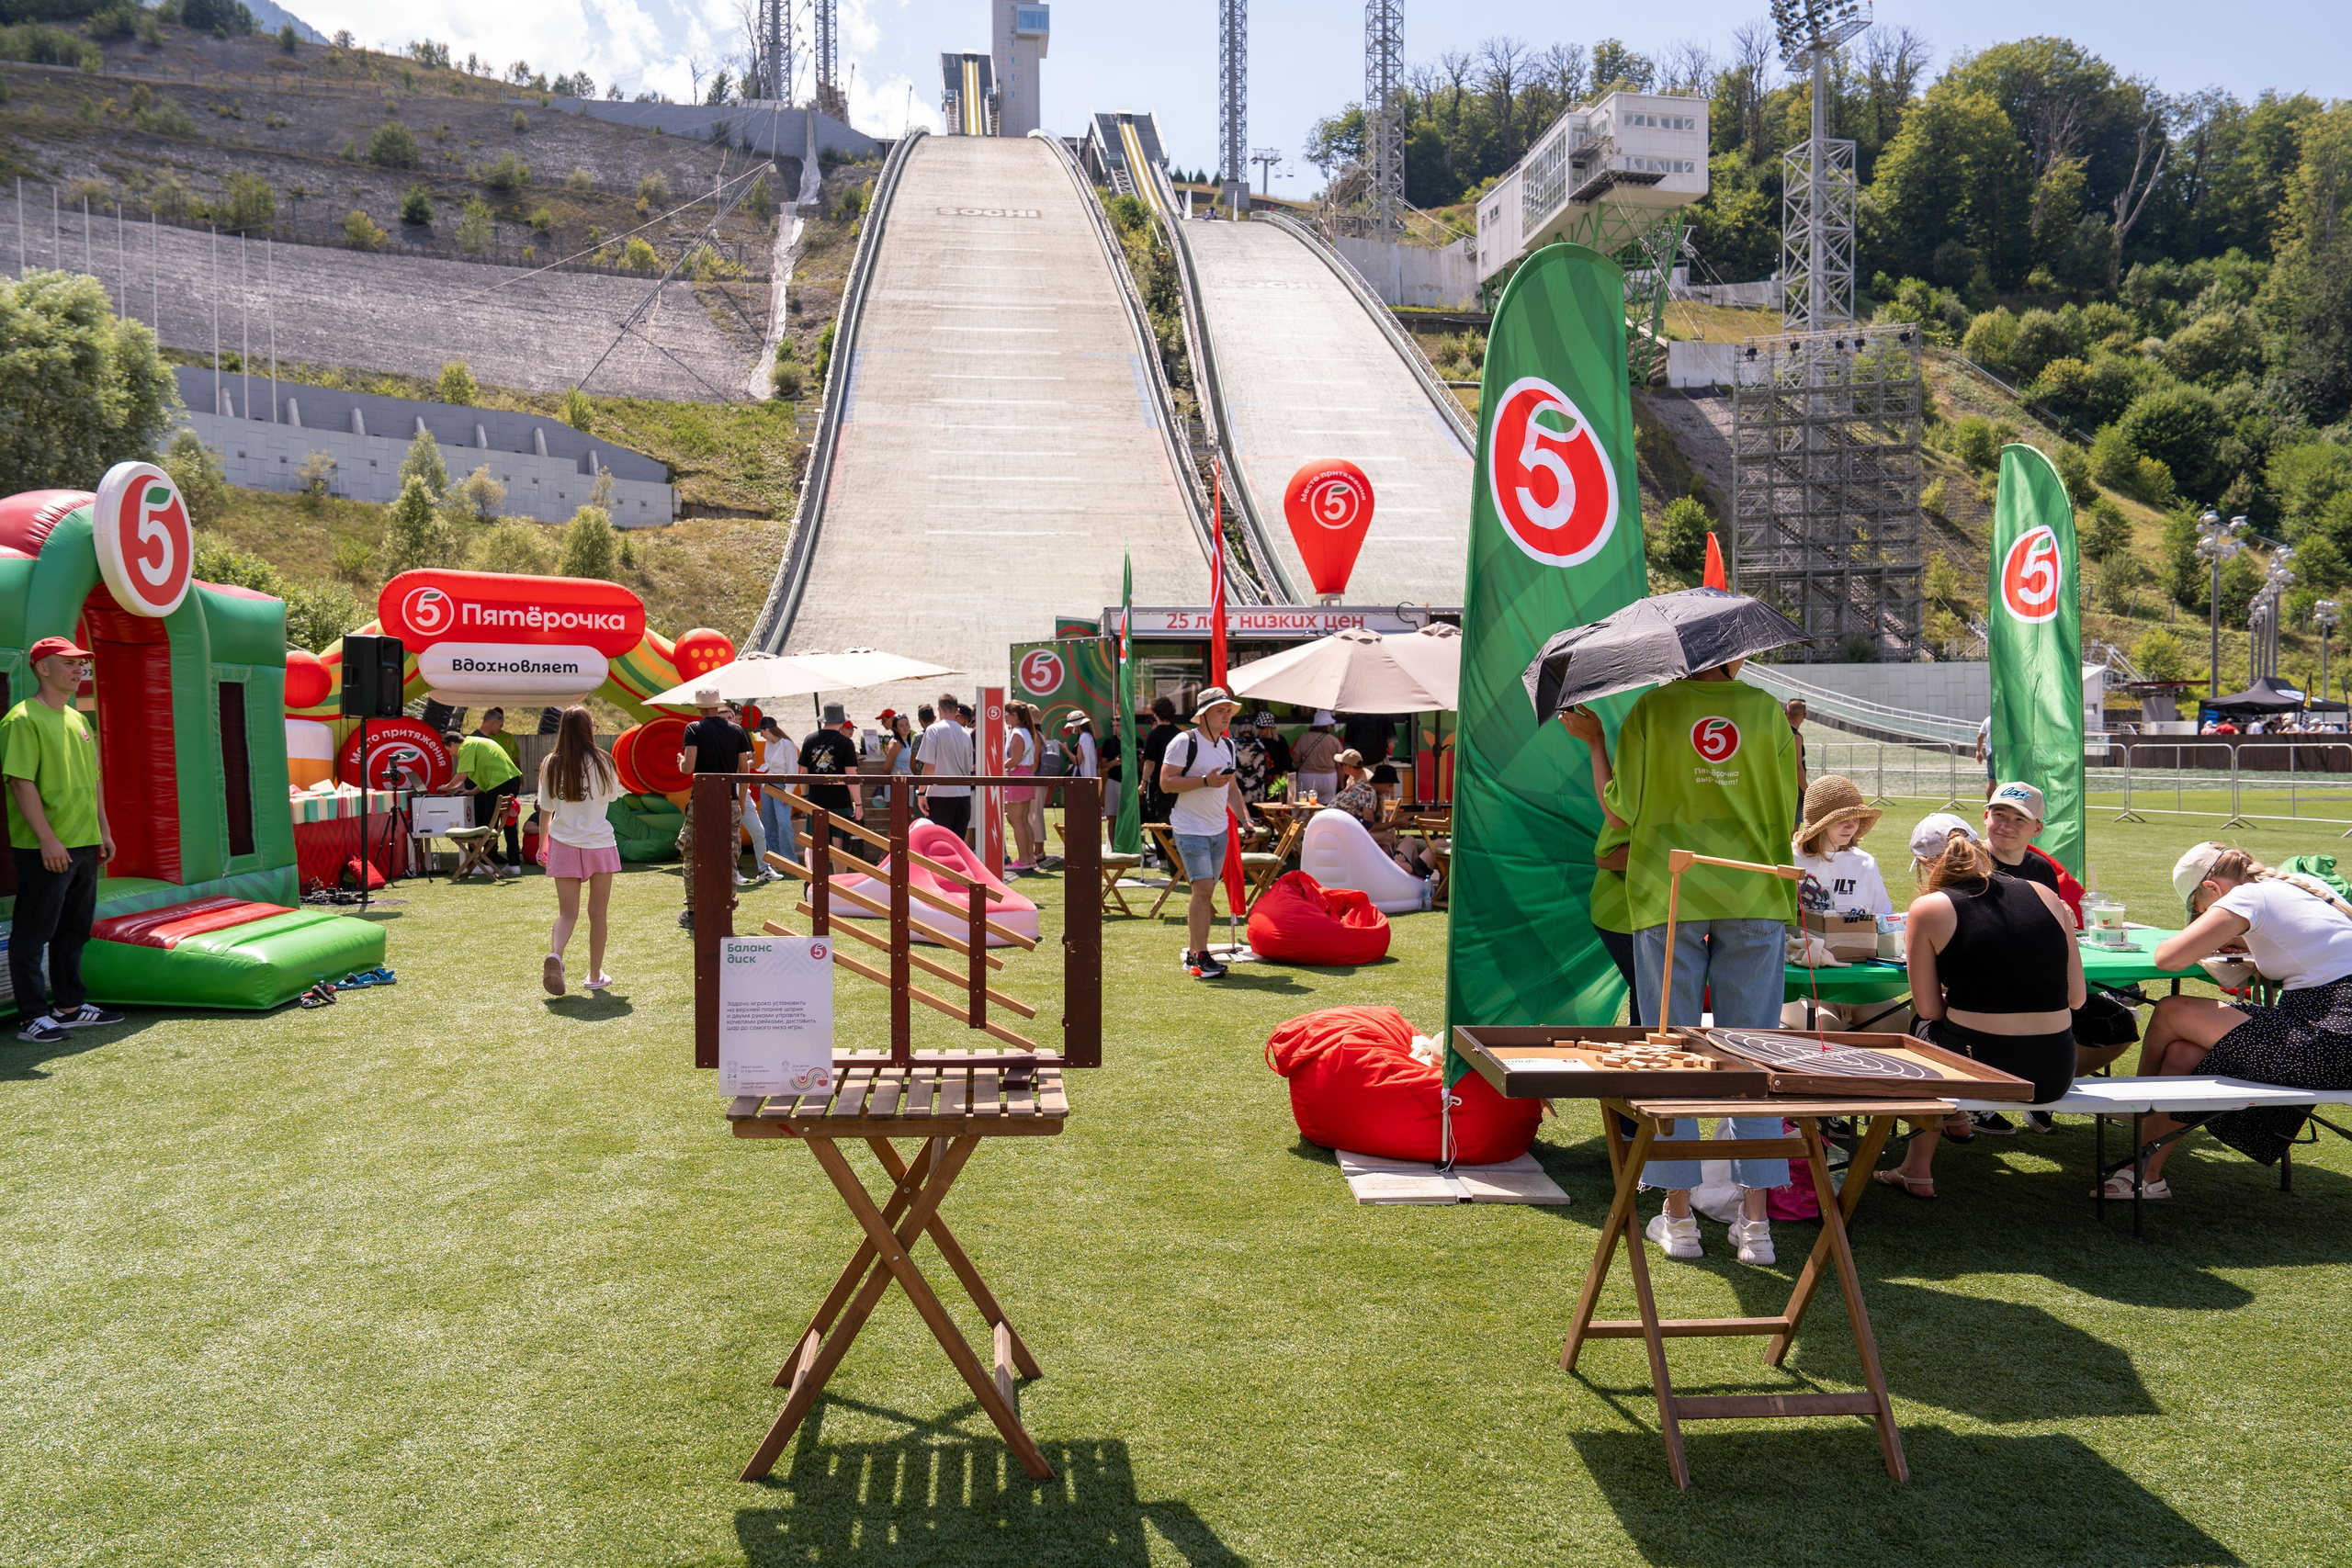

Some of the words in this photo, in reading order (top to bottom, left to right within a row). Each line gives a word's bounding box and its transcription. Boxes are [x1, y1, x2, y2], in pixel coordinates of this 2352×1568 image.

[938, 207, 1037, 218] SOCHI
[1515, 400, 1583, 530] 5
[1300, 477, 1319, 502] Место
[1320, 470, 1366, 501] притяжения
[1323, 484, 1351, 520] 5
[138, 479, 175, 586] 5
[2018, 531, 2054, 605] 5
[415, 592, 443, 627] 5
[462, 603, 626, 633] Пятёрочка
[1167, 614, 1190, 629] 25
[1239, 615, 1317, 629] низких
[1325, 615, 1364, 632] цен
[452, 658, 579, 674] Вдохновляет
[1030, 653, 1055, 687] 5
[349, 734, 380, 764] Мето
[382, 728, 447, 767] притяжения
[1703, 720, 1728, 755] 5
[727, 943, 773, 953] Баланс
[727, 953, 756, 964] диск
